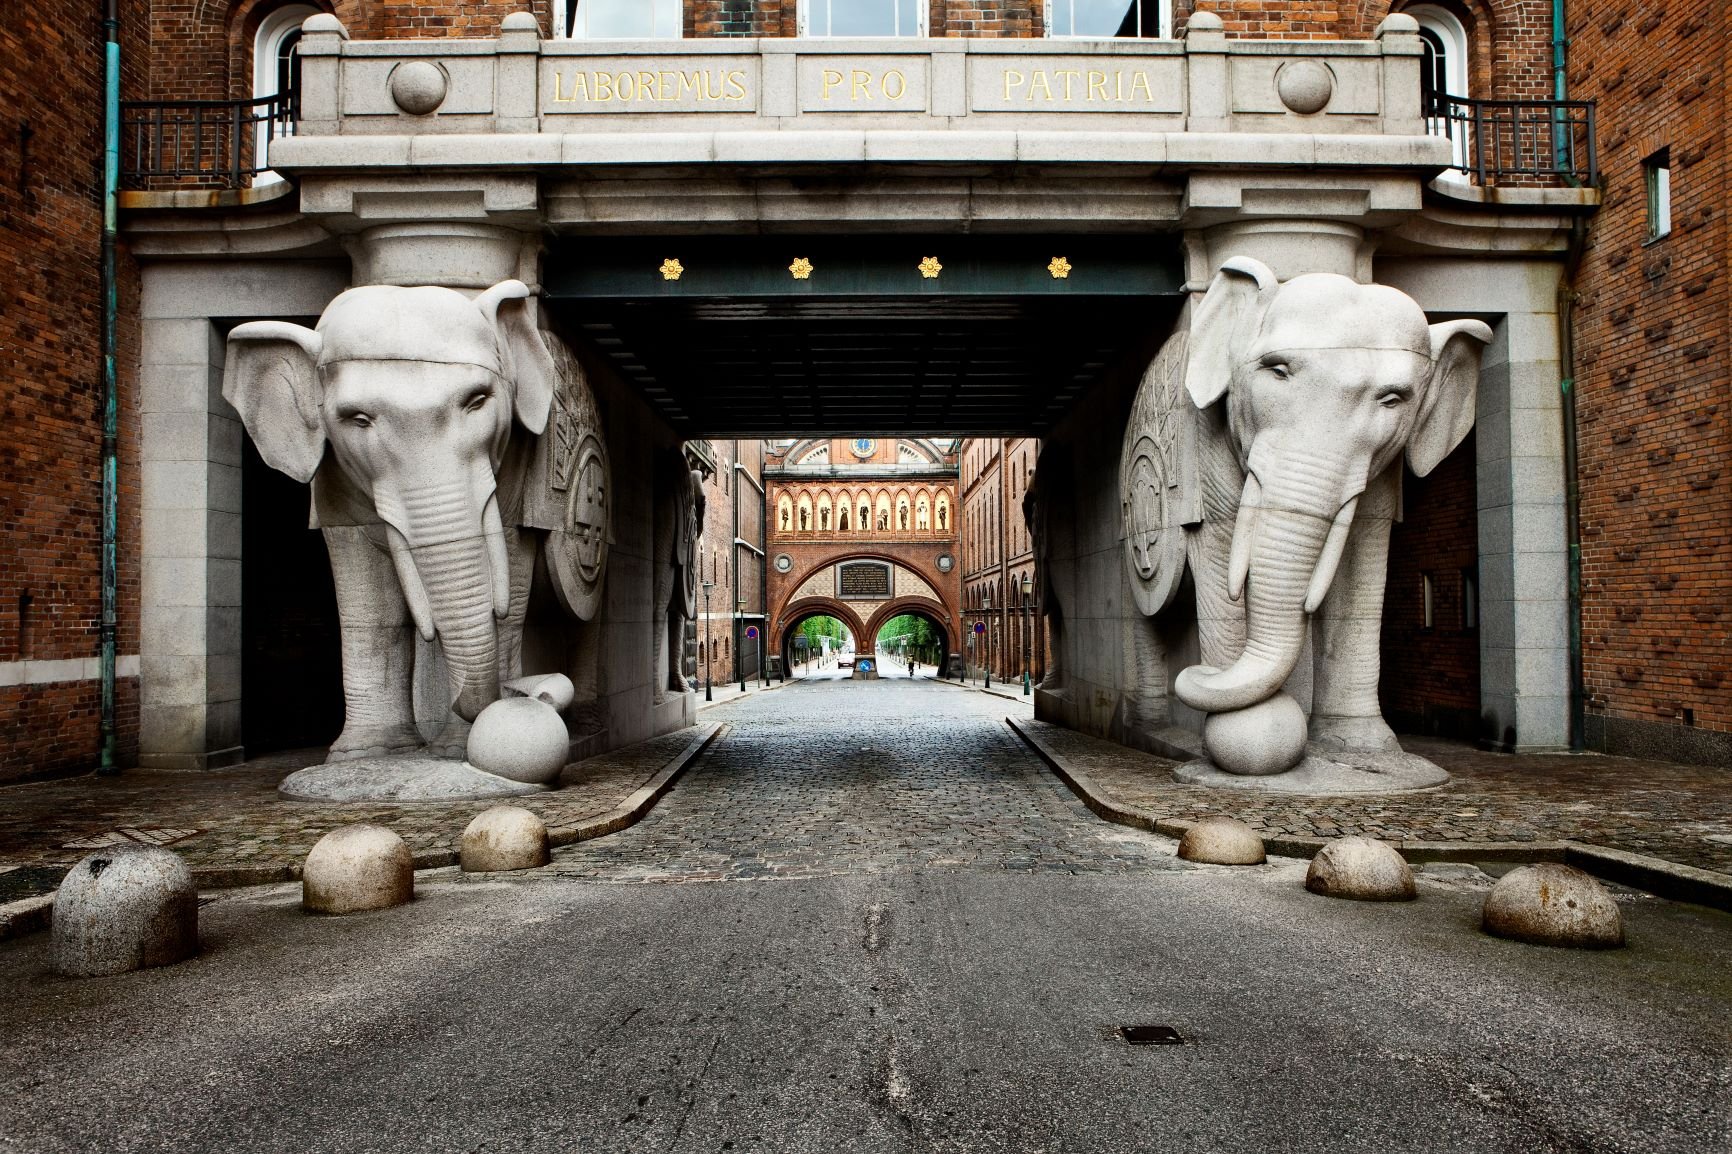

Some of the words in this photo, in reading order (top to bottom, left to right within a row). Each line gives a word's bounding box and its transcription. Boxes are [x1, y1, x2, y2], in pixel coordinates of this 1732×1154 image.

[554, 70, 747, 102] LABOREMUS
[822, 69, 906, 101] PRO
[1003, 69, 1154, 102] PATRIA
